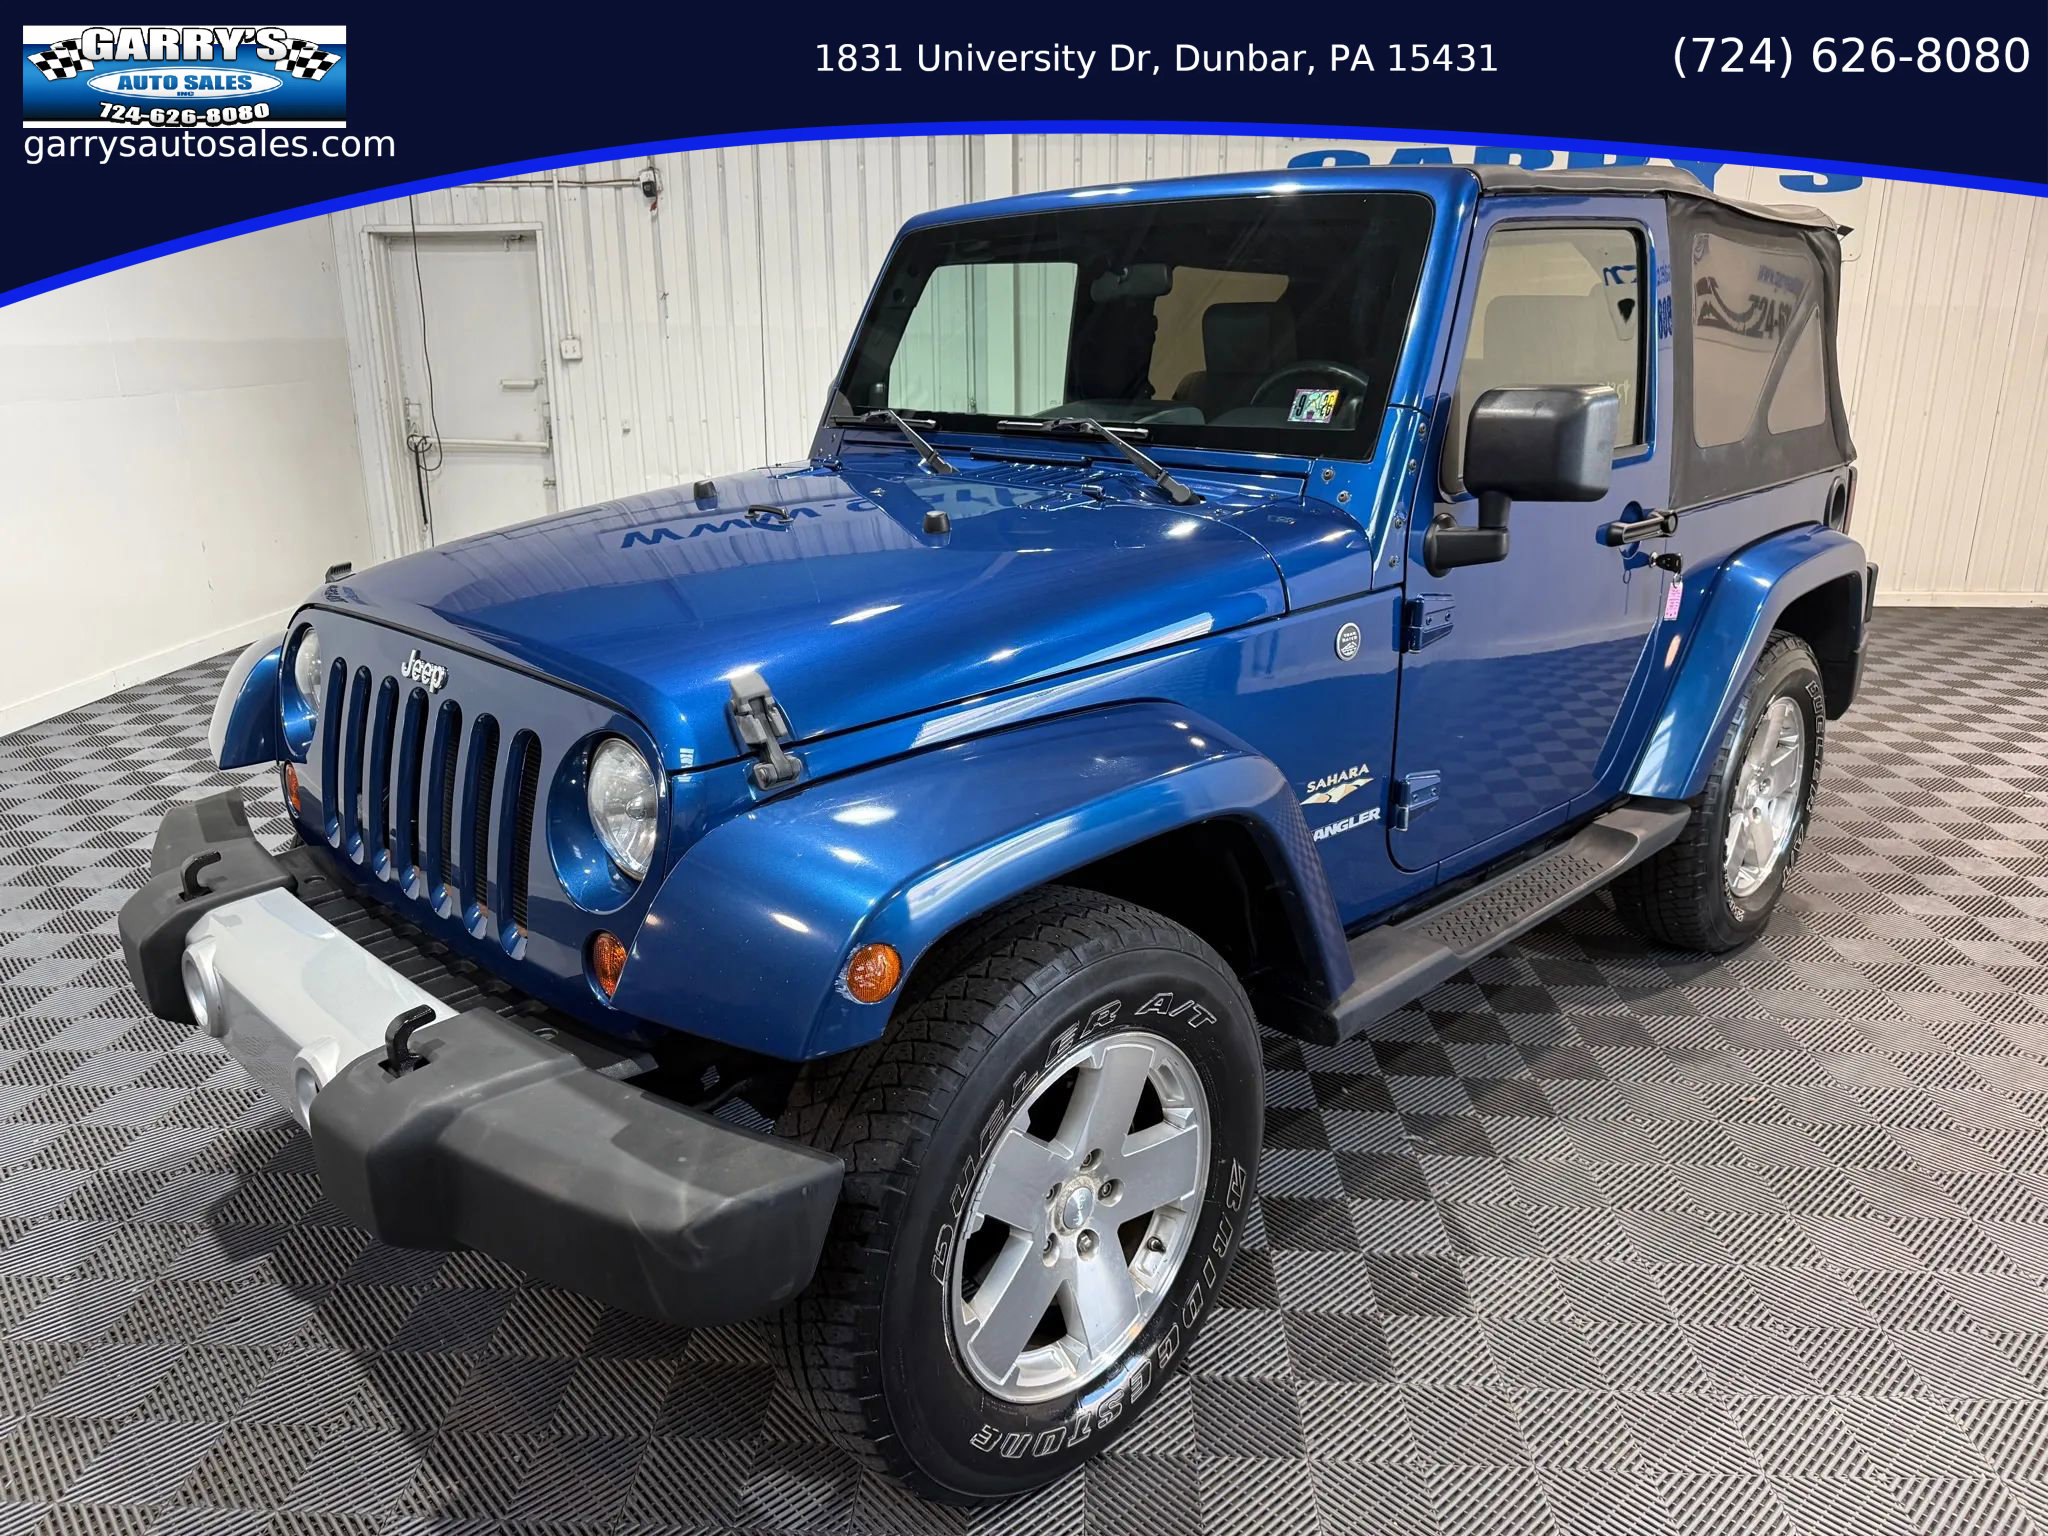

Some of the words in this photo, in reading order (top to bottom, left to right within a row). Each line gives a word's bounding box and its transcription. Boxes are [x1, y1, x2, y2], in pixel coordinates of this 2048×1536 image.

[401, 649, 447, 694] Jeep
[1306, 763, 1370, 793] SAHARA
[1311, 806, 1382, 842] ANGLER
[930, 999, 1122, 1288] DUELER
[1134, 991, 1218, 1029] A/T
[969, 1157, 1246, 1458] BRIDGESTONE
